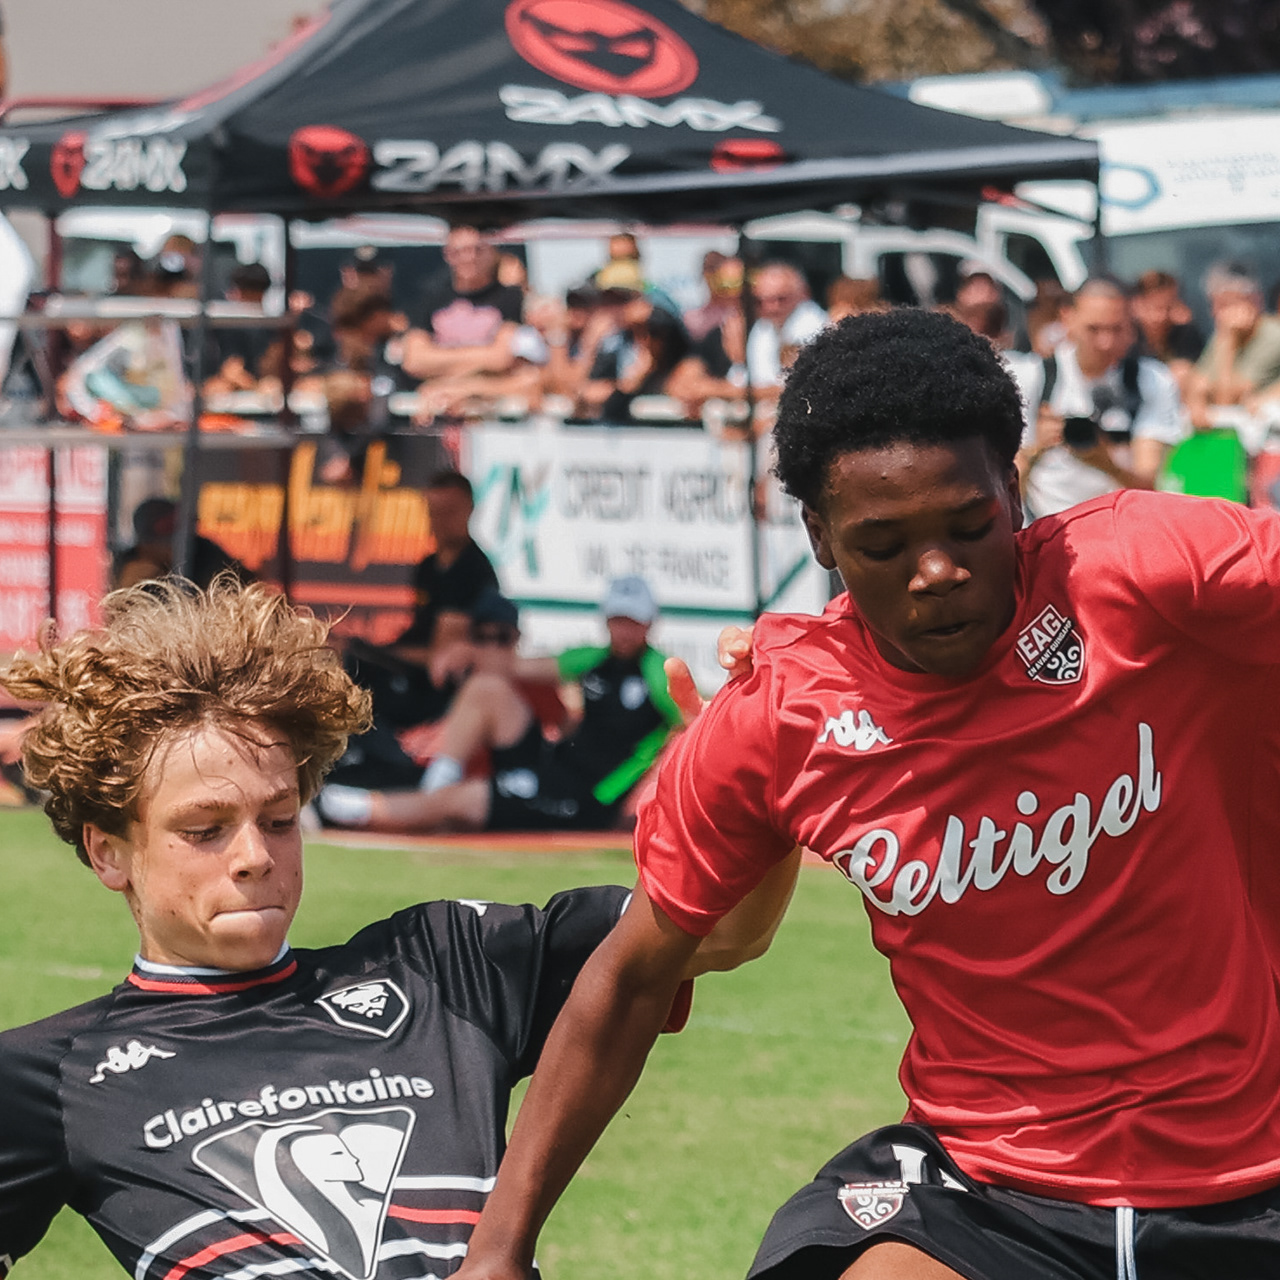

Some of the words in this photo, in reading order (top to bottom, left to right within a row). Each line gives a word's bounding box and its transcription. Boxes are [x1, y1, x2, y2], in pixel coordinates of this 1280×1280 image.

[371, 139, 631, 194] 24MX
[1016, 612, 1062, 661] EAG
[832, 722, 1162, 917] Celtigel
[143, 1067, 435, 1149] Clairefontaine
